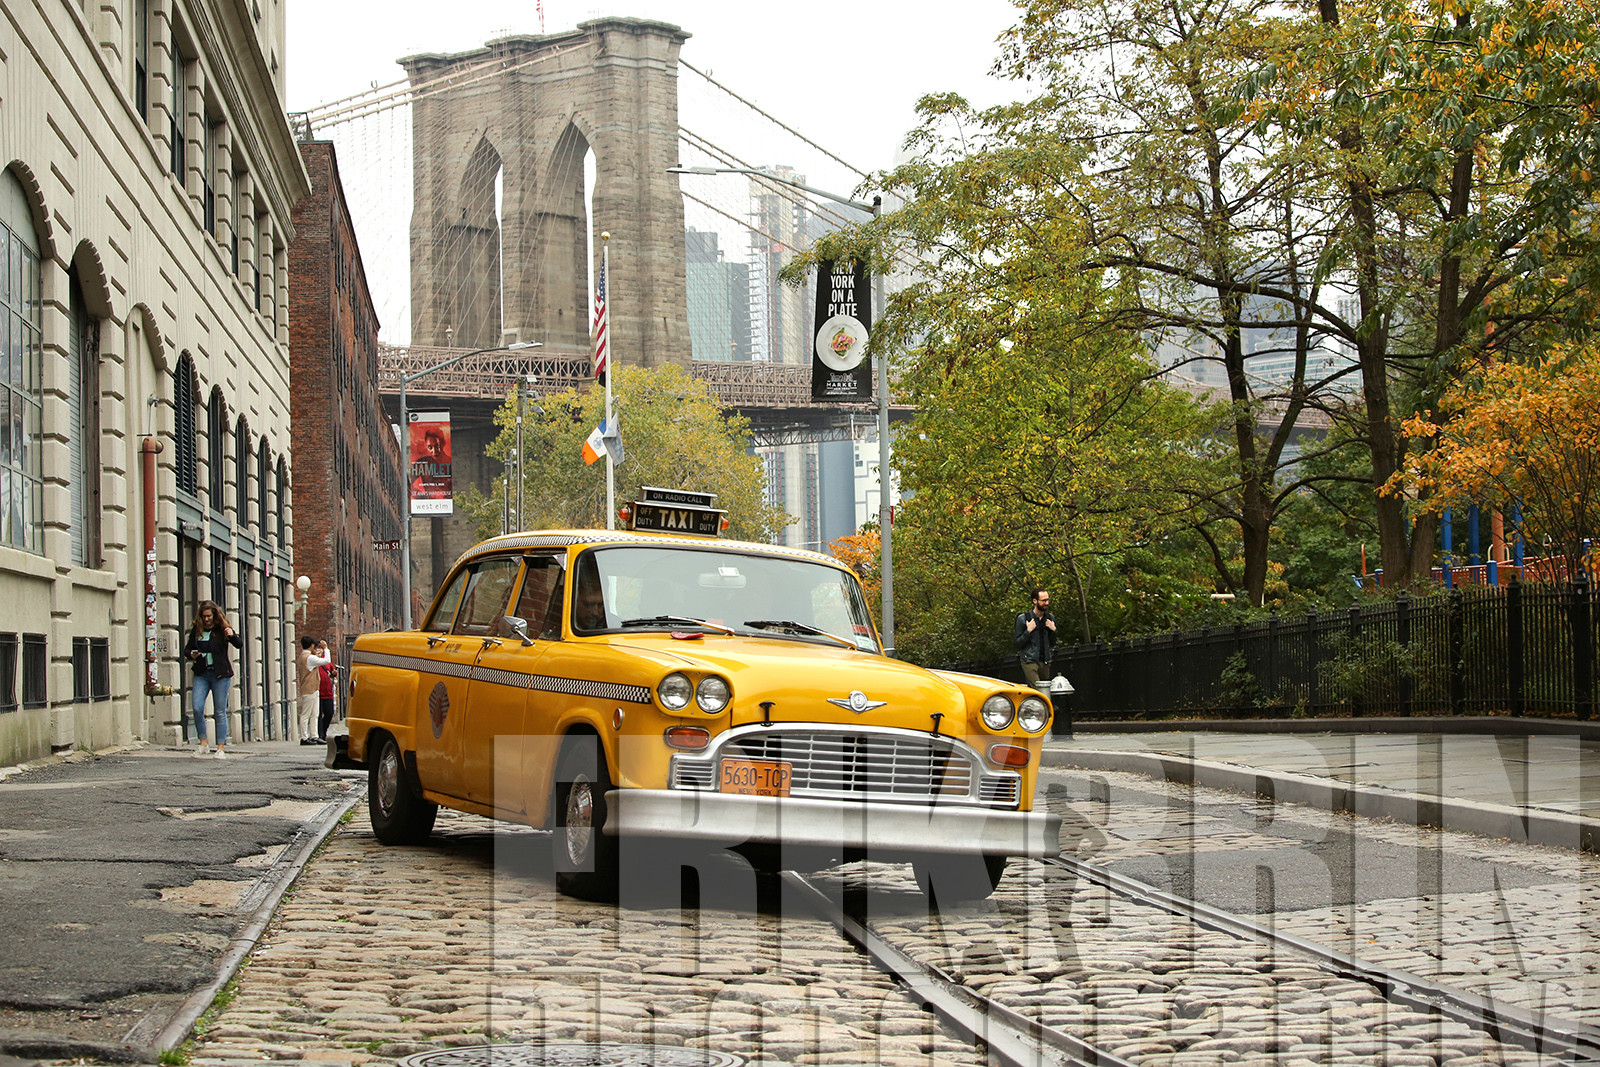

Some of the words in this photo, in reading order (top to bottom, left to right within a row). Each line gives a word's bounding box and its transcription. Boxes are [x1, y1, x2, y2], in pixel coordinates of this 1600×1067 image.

[830, 275, 855, 289] YORK
[831, 289, 844, 303] ON
[847, 289, 854, 303] A
[828, 303, 858, 317] PLATE
[411, 463, 451, 476] HAMLET
[653, 492, 663, 500] ON
[665, 494, 686, 502] RADIO
[687, 496, 703, 504] CALL
[640, 507, 653, 515] OFF
[702, 512, 715, 521] OFF
[637, 517, 654, 526] DUTY
[659, 509, 694, 530] TAXI
[699, 523, 716, 532] DUTY
[373, 542, 390, 550] Main
[392, 542, 399, 550] St
[725, 765, 788, 788] 5630-TCP
[755, 788, 772, 796] YORK
